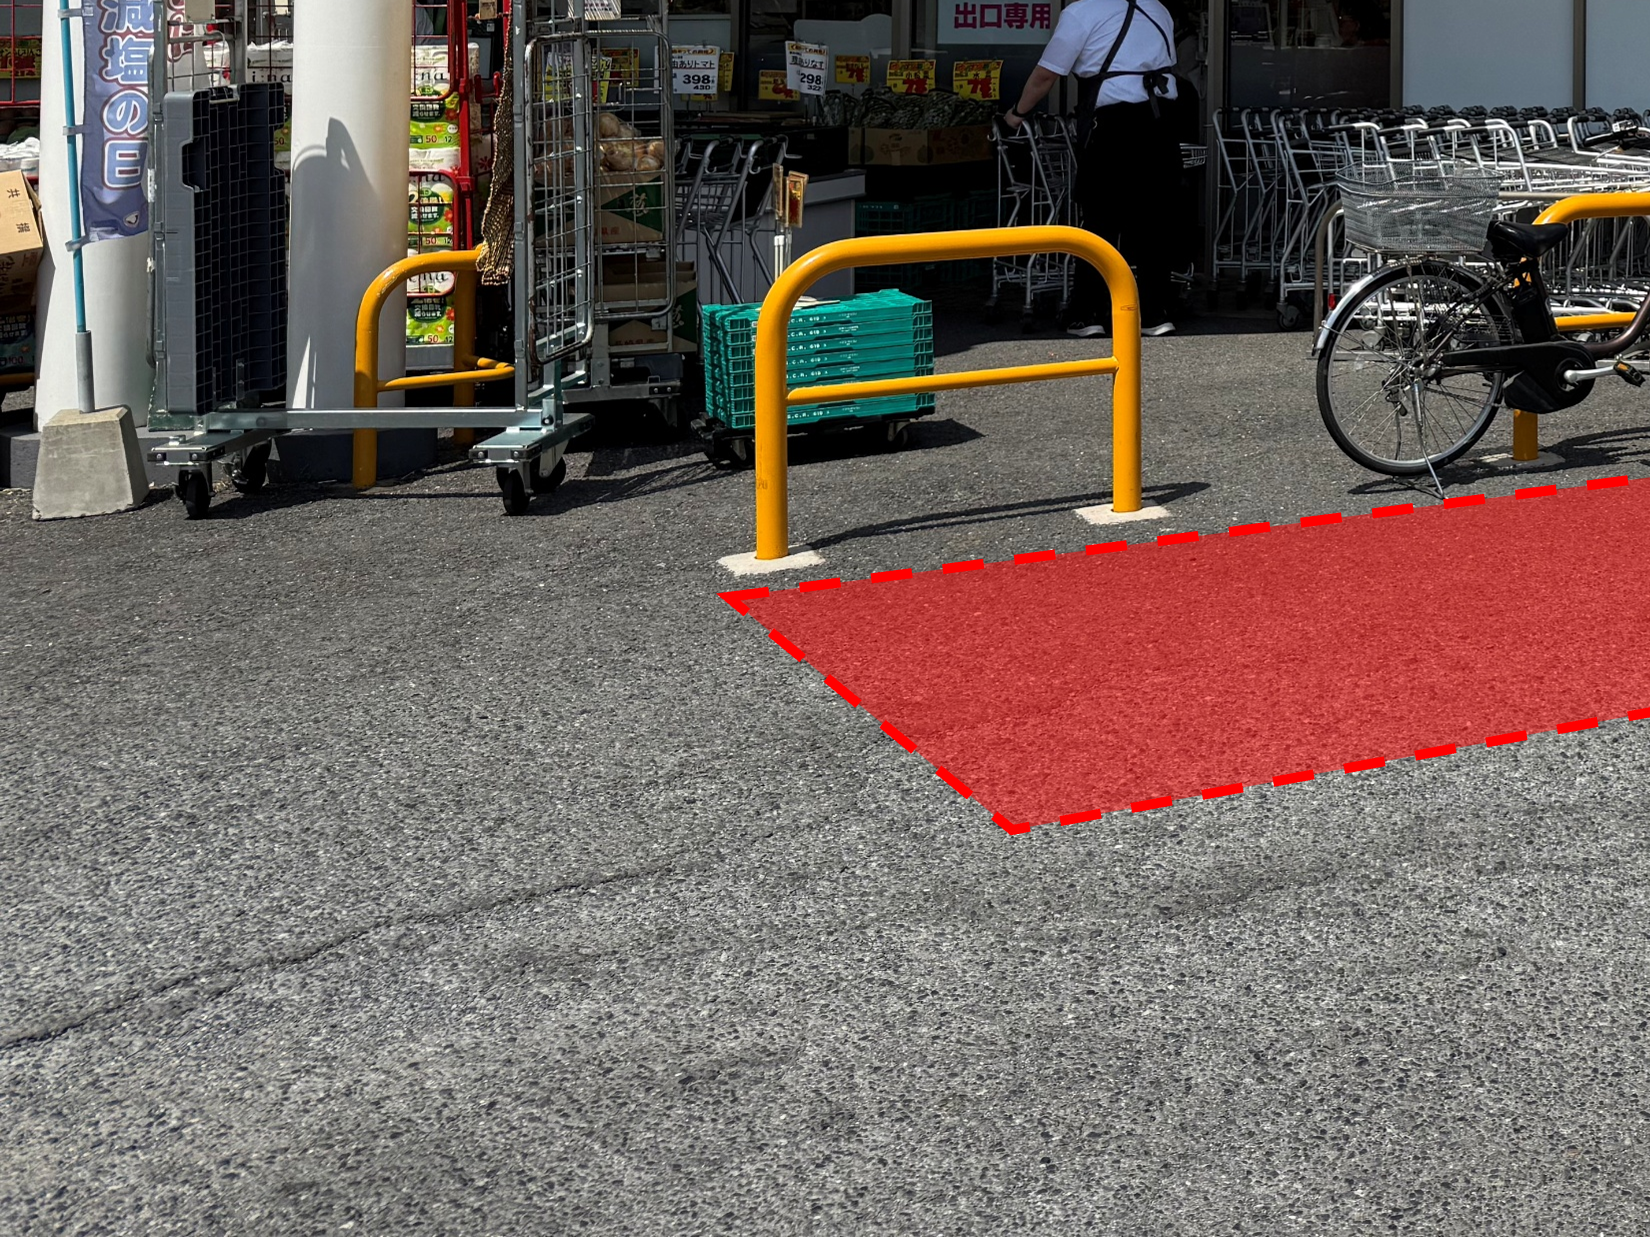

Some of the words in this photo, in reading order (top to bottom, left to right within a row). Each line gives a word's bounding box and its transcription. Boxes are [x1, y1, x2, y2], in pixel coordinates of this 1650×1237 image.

[953, 3, 1051, 29] 出口専用
[683, 74, 711, 84] 398
[800, 72, 822, 85] 298
[425, 135, 438, 143] 50
[427, 335, 438, 343] 50
